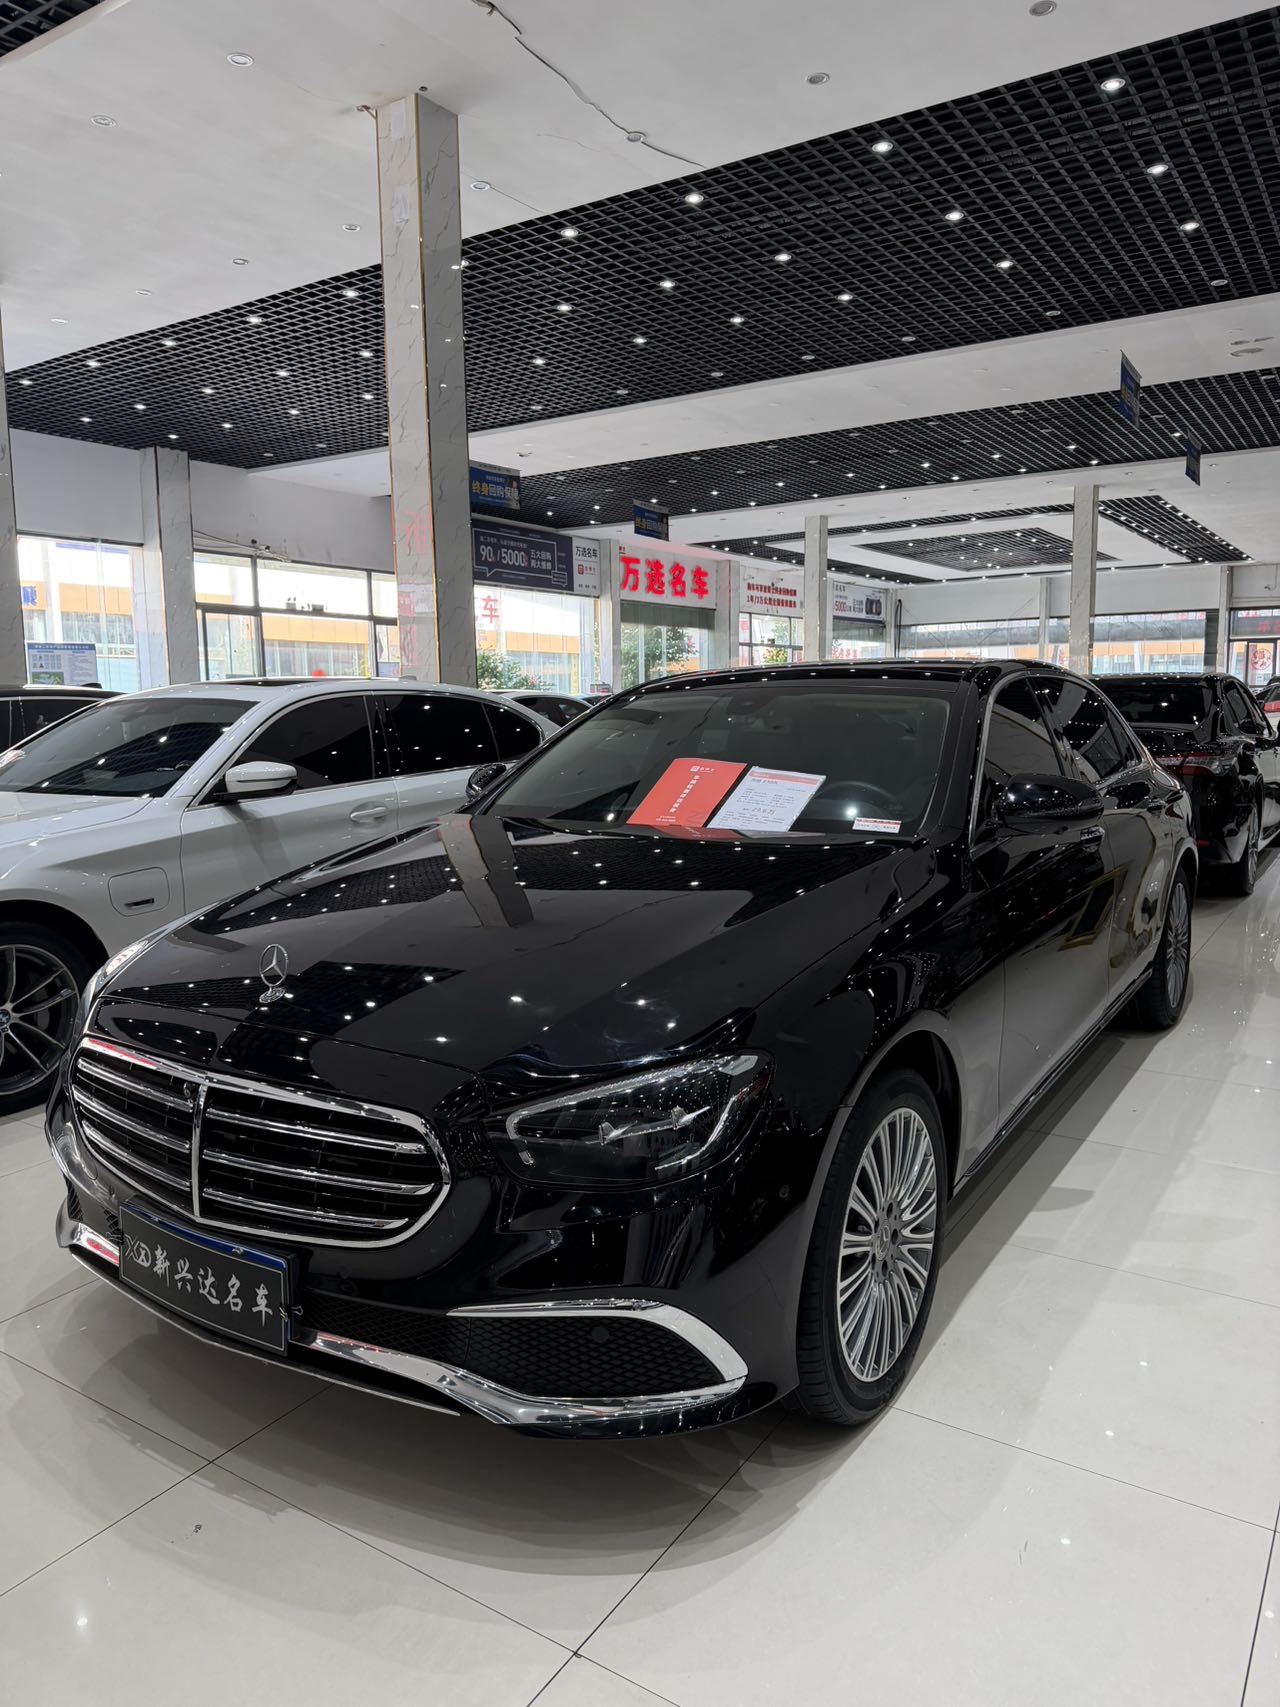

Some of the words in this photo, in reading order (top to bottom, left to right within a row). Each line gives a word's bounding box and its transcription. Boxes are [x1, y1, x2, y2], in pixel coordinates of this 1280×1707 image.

[621, 556, 710, 600] 万选名车
[153, 1244, 274, 1327] 新兴达名车
